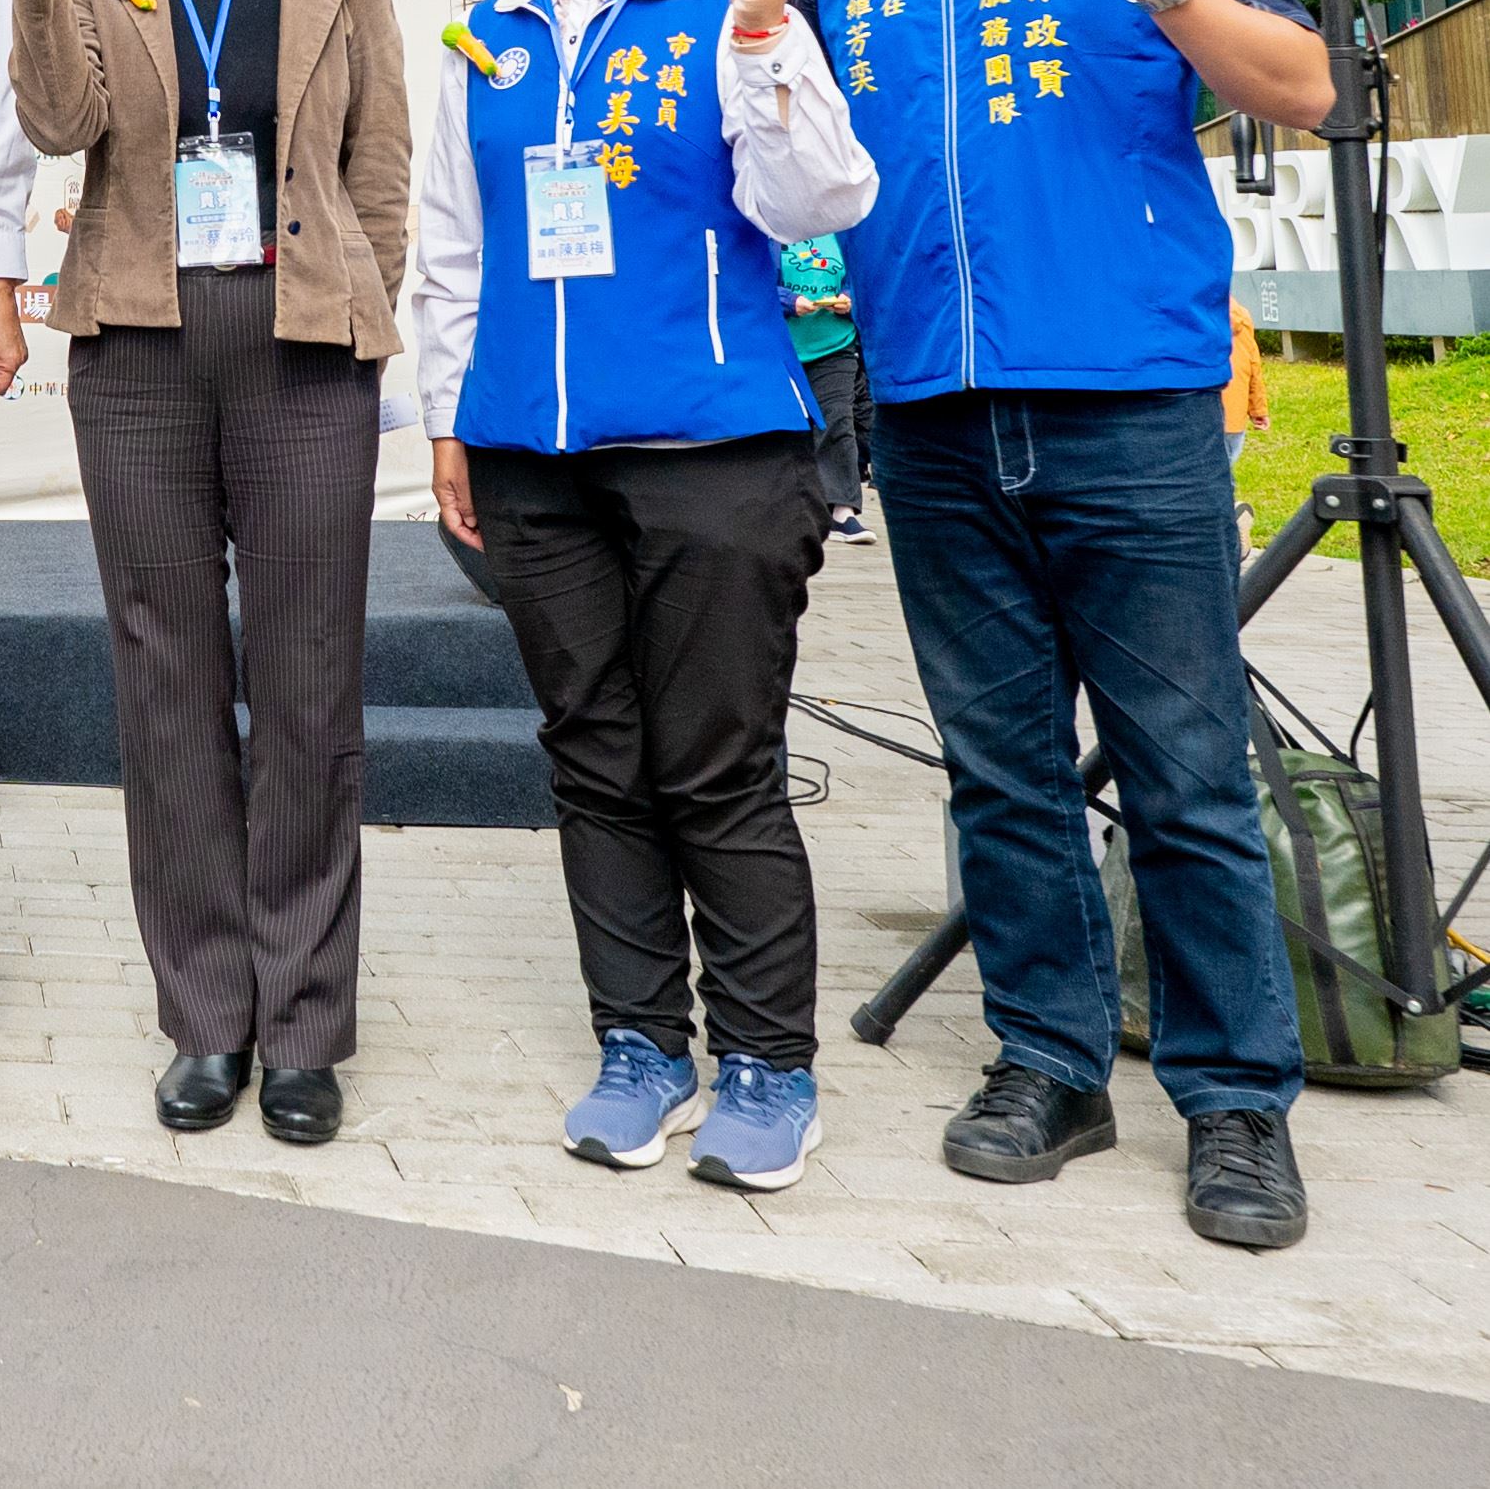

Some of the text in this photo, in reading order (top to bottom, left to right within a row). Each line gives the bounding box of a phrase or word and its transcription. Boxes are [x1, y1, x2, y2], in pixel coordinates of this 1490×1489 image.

[595, 45, 650, 189] 陳美梅
[654, 32, 697, 132] 市議員
[15, 290, 53, 320] 場
